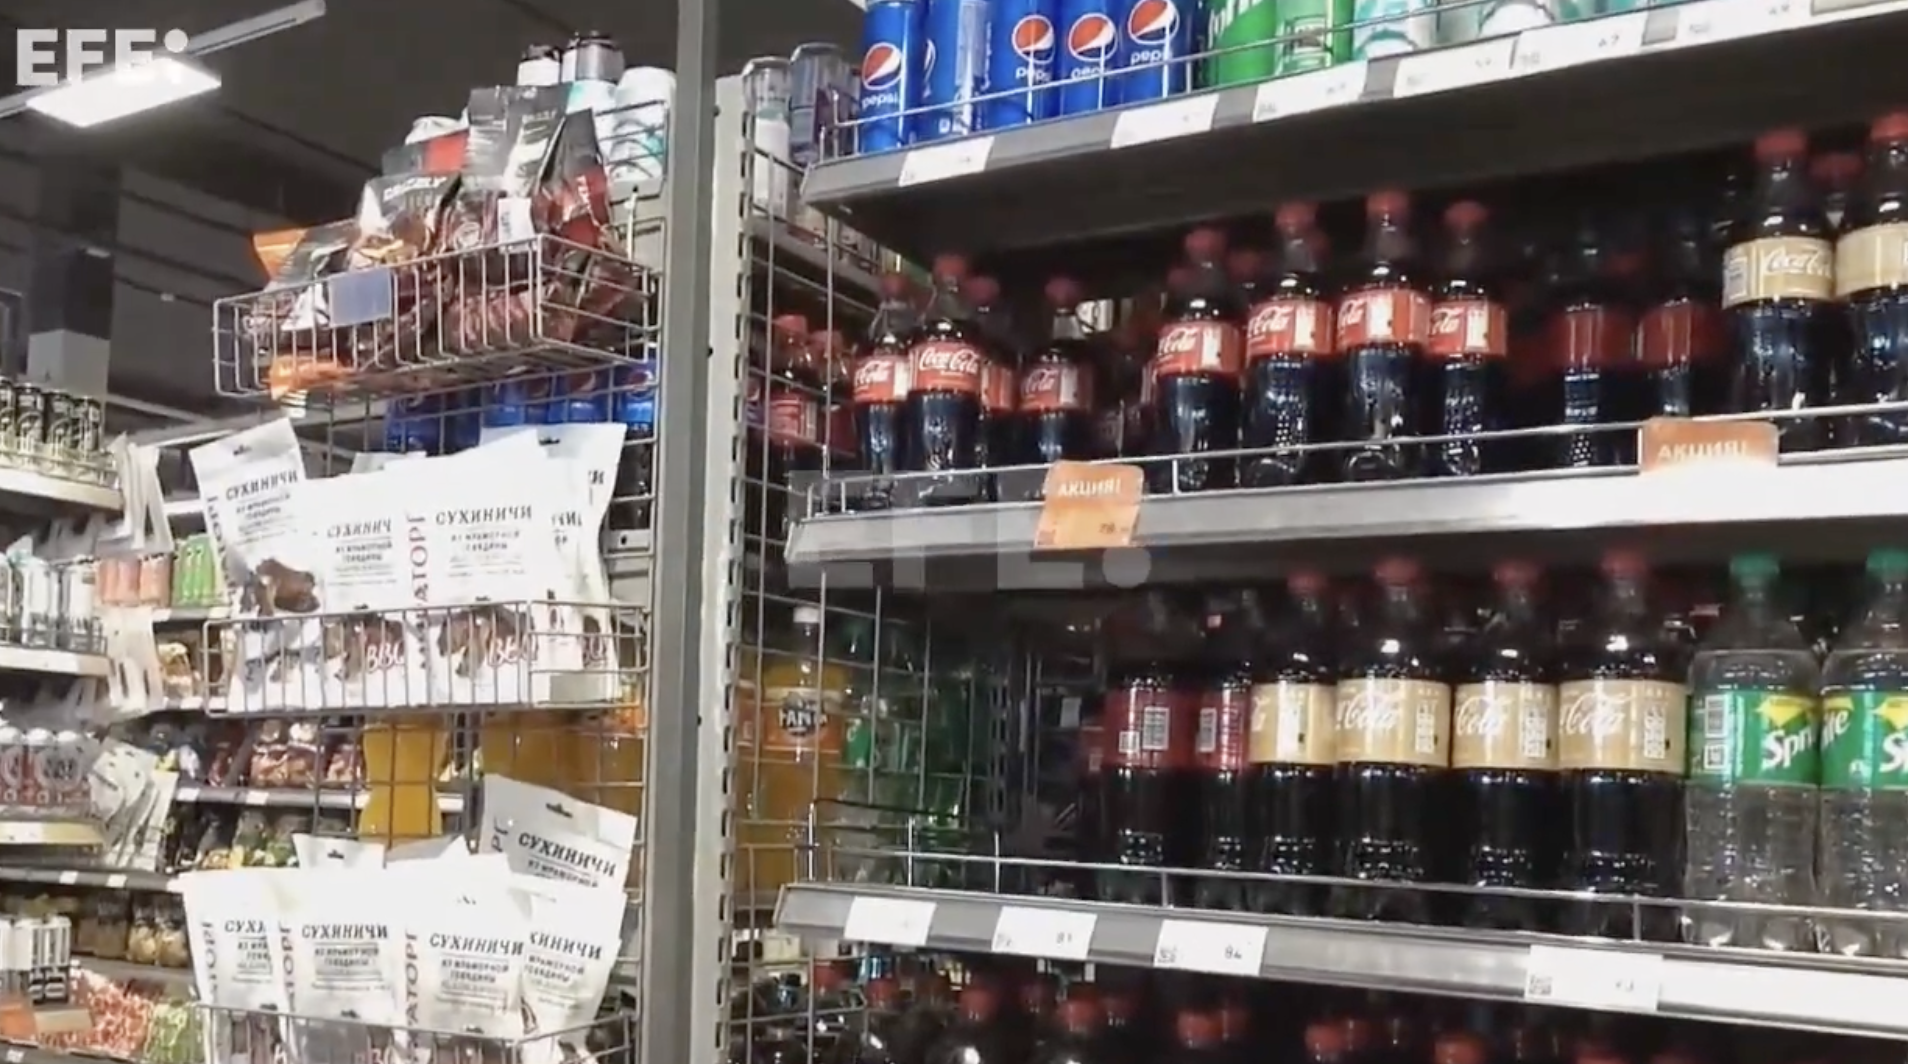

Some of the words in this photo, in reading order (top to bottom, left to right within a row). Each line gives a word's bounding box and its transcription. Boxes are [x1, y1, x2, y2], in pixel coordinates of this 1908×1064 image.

[226, 469, 298, 501] СУХИНИЧИ
[435, 505, 532, 525] СУХИНИЧИ
[327, 517, 392, 539] СУХИНИЧ
[518, 832, 616, 877] СУХИНИЧИ
[302, 924, 389, 940] СУХИНИЧИ
[429, 933, 524, 955] СУХИНИЧИ
